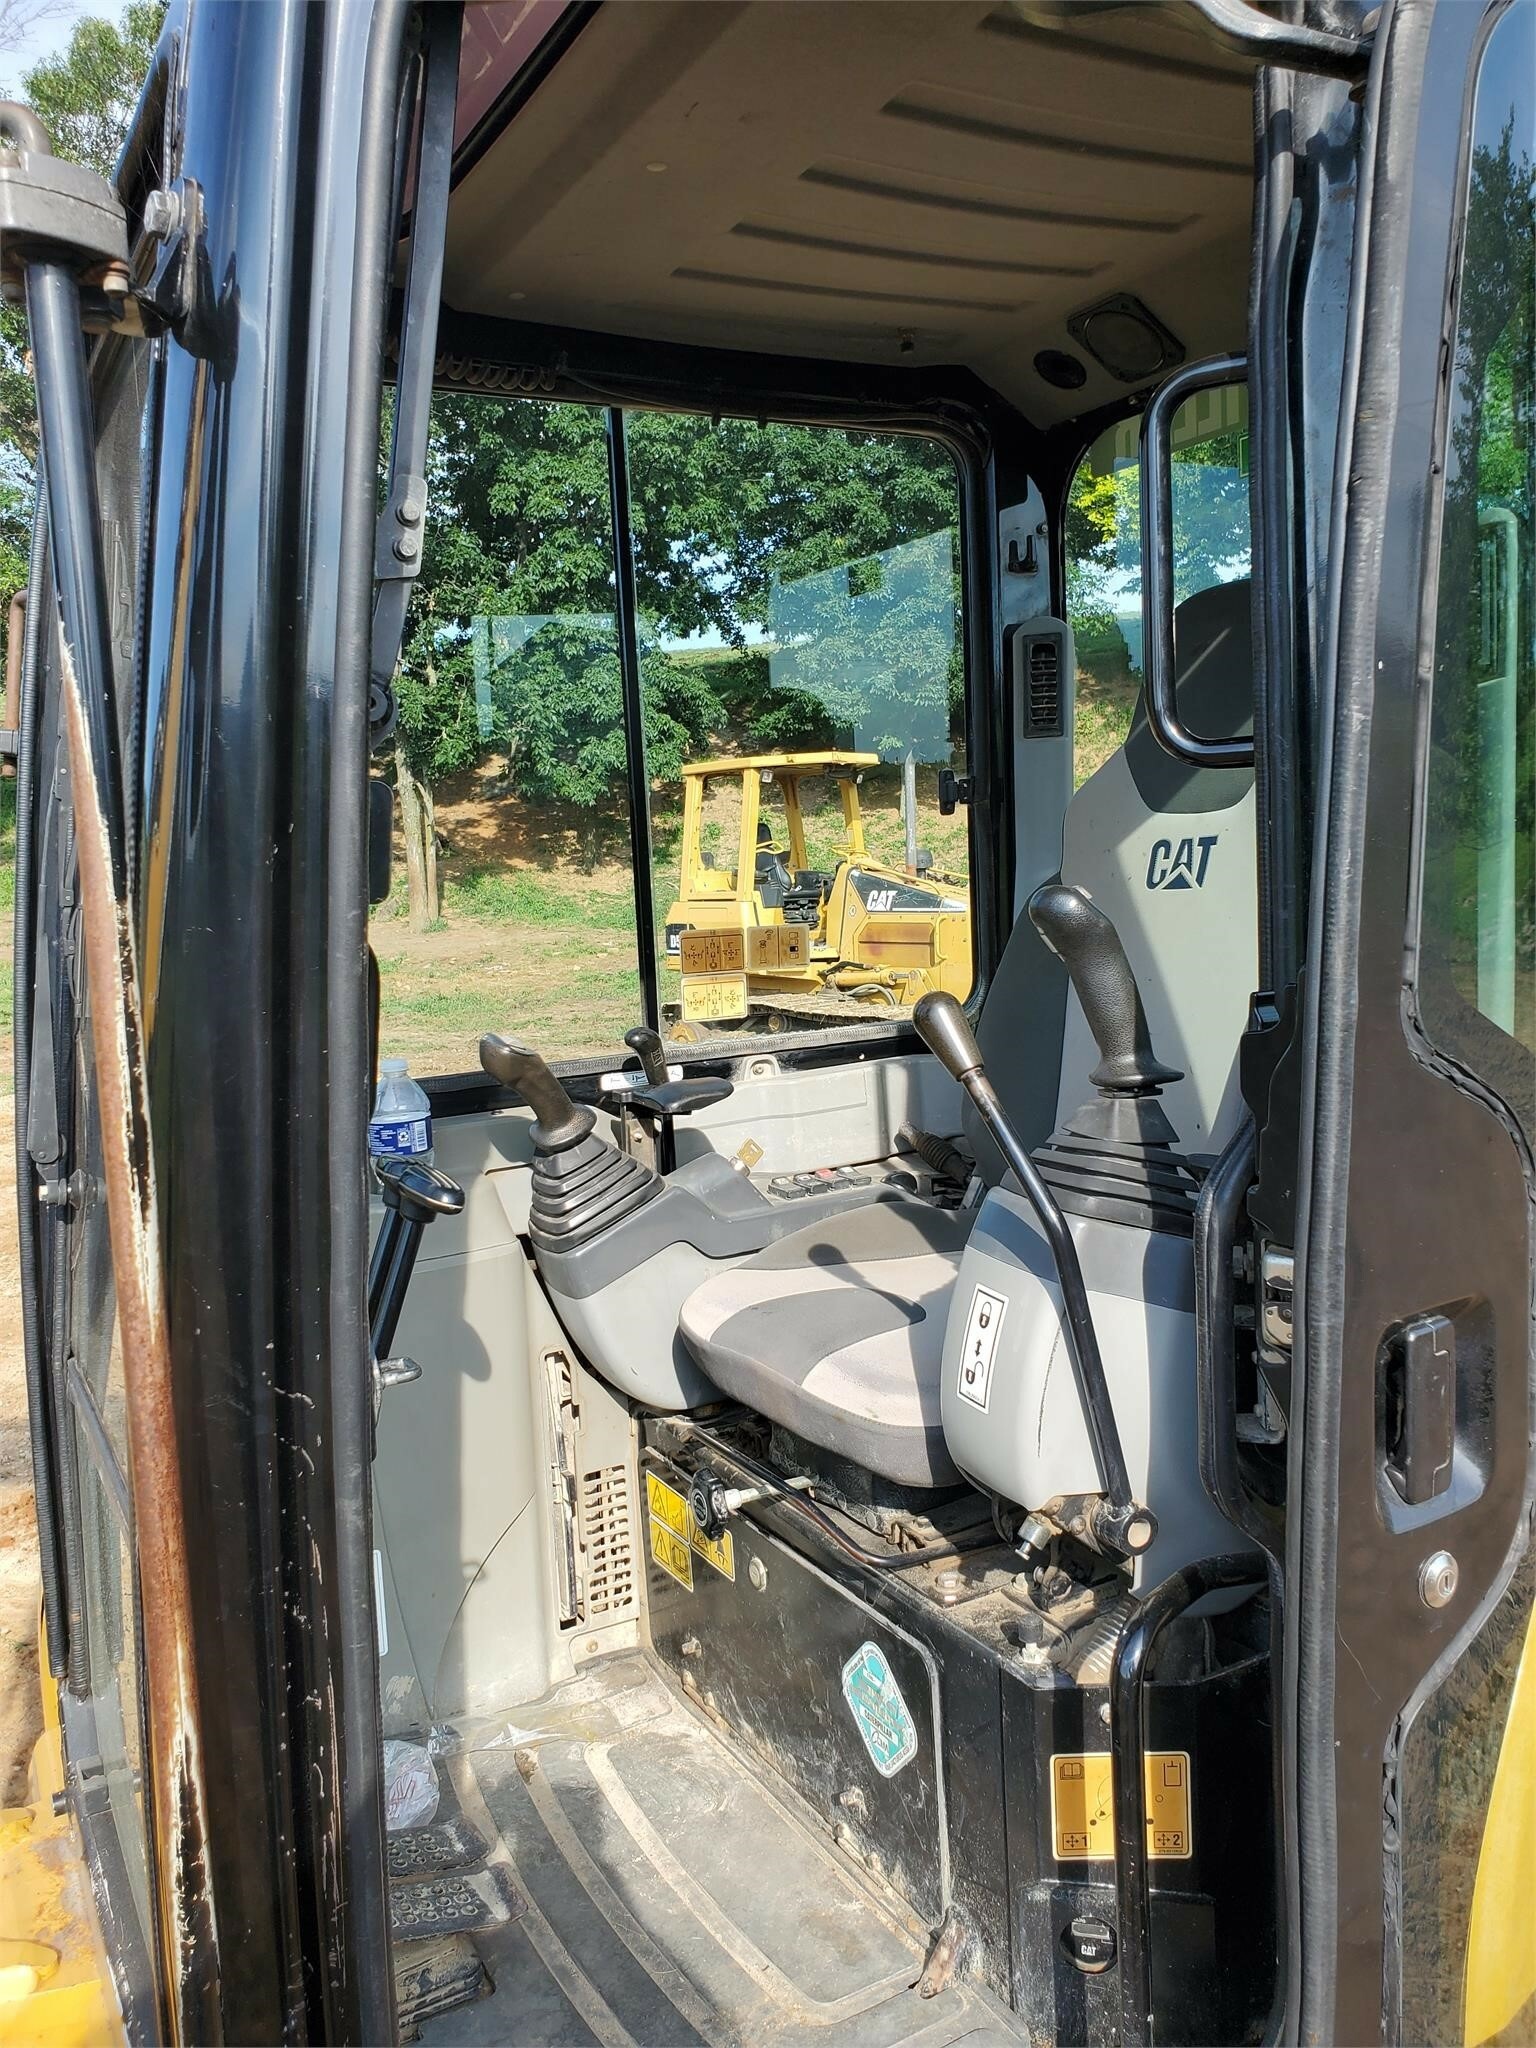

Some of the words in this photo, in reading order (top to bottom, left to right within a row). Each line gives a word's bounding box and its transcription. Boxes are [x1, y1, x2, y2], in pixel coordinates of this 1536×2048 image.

[1145, 835, 1219, 890] CAT
[867, 890, 897, 911] CAT
[1173, 1834, 1181, 1846] 2
[1081, 1944, 1097, 1956] CAT
